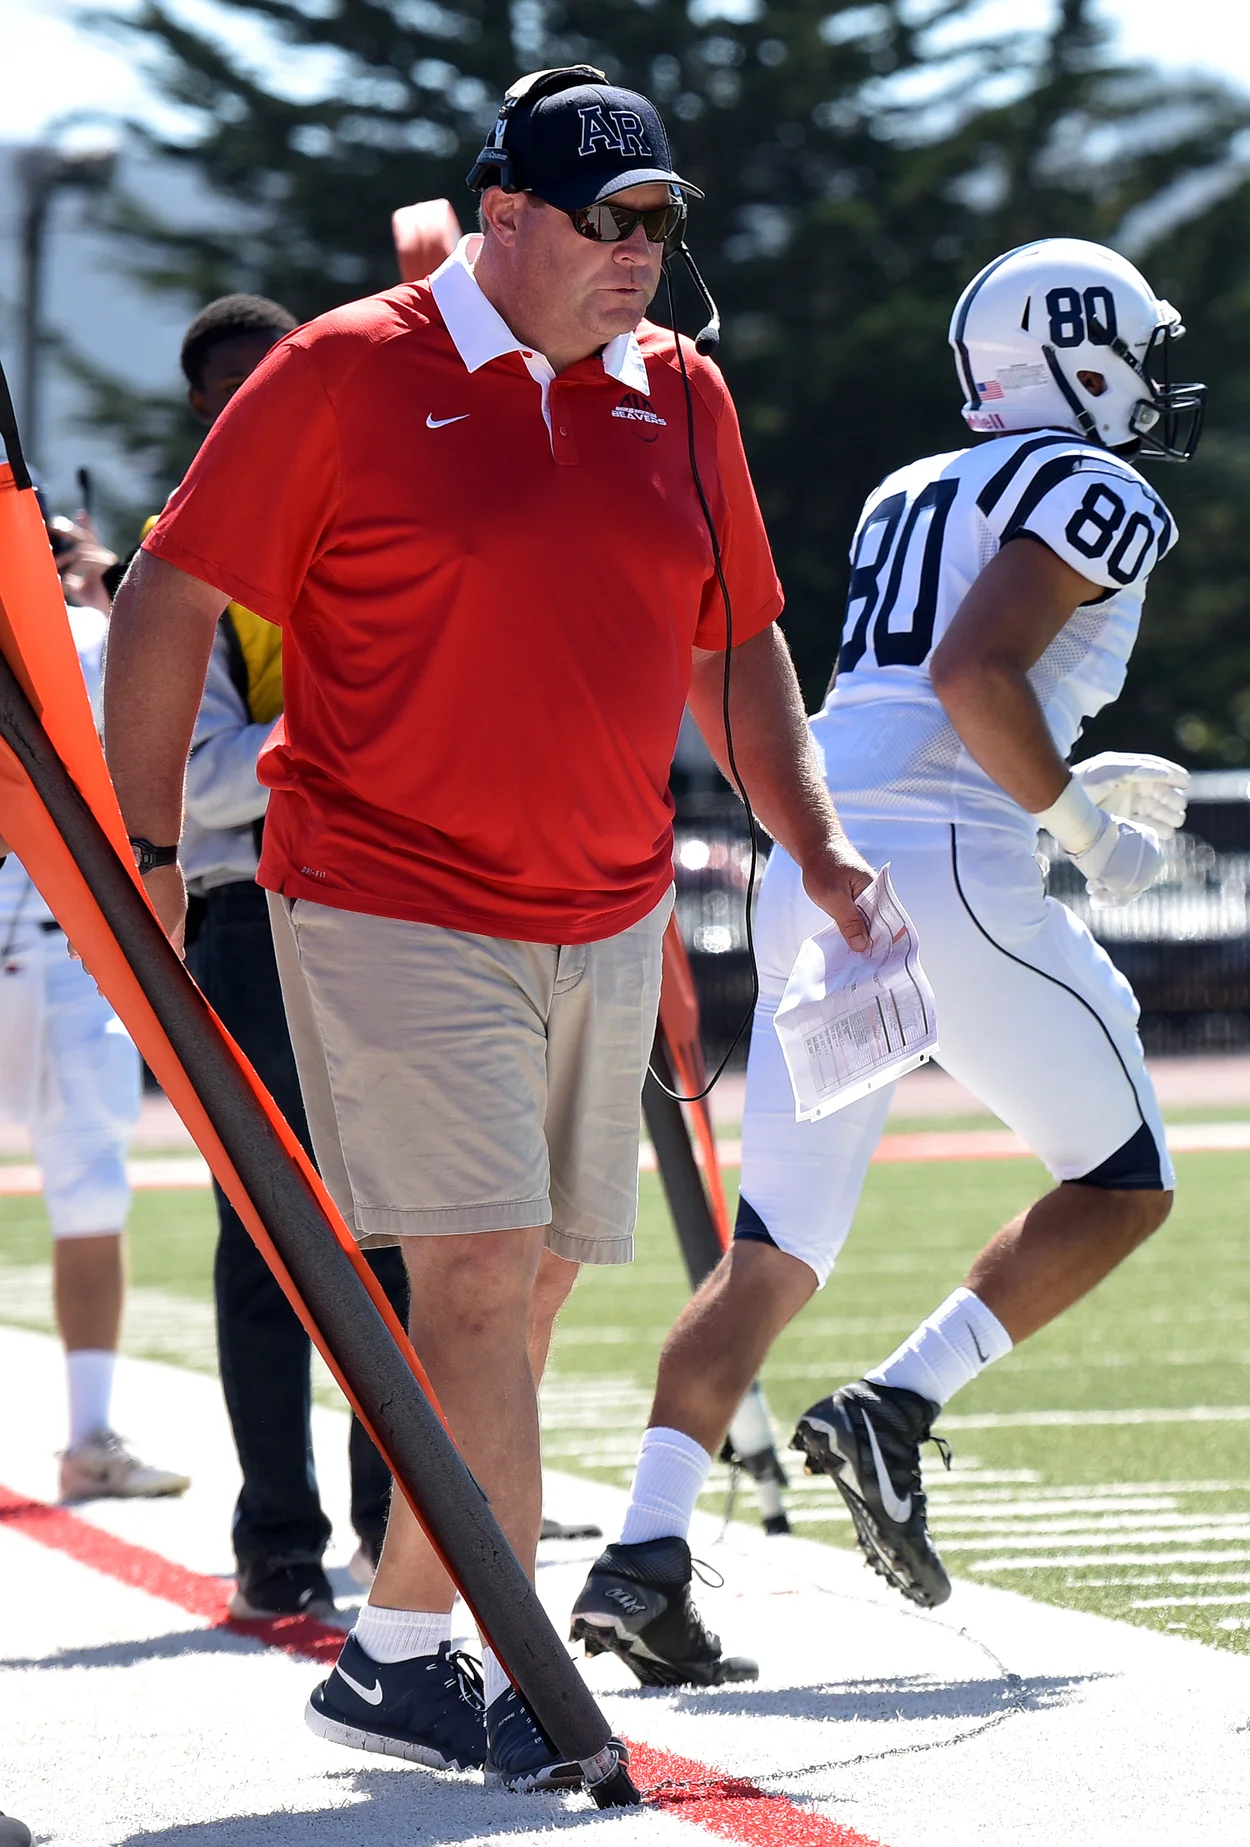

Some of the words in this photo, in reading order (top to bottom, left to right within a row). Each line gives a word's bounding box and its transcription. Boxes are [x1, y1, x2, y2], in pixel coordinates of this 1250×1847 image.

[577, 105, 652, 156] AR
[1045, 286, 1118, 348] 80
[611, 409, 667, 426] BEAVERS
[1064, 482, 1155, 586] 80
[839, 478, 961, 673] 80
[301, 866, 327, 878] DRI-FIT
